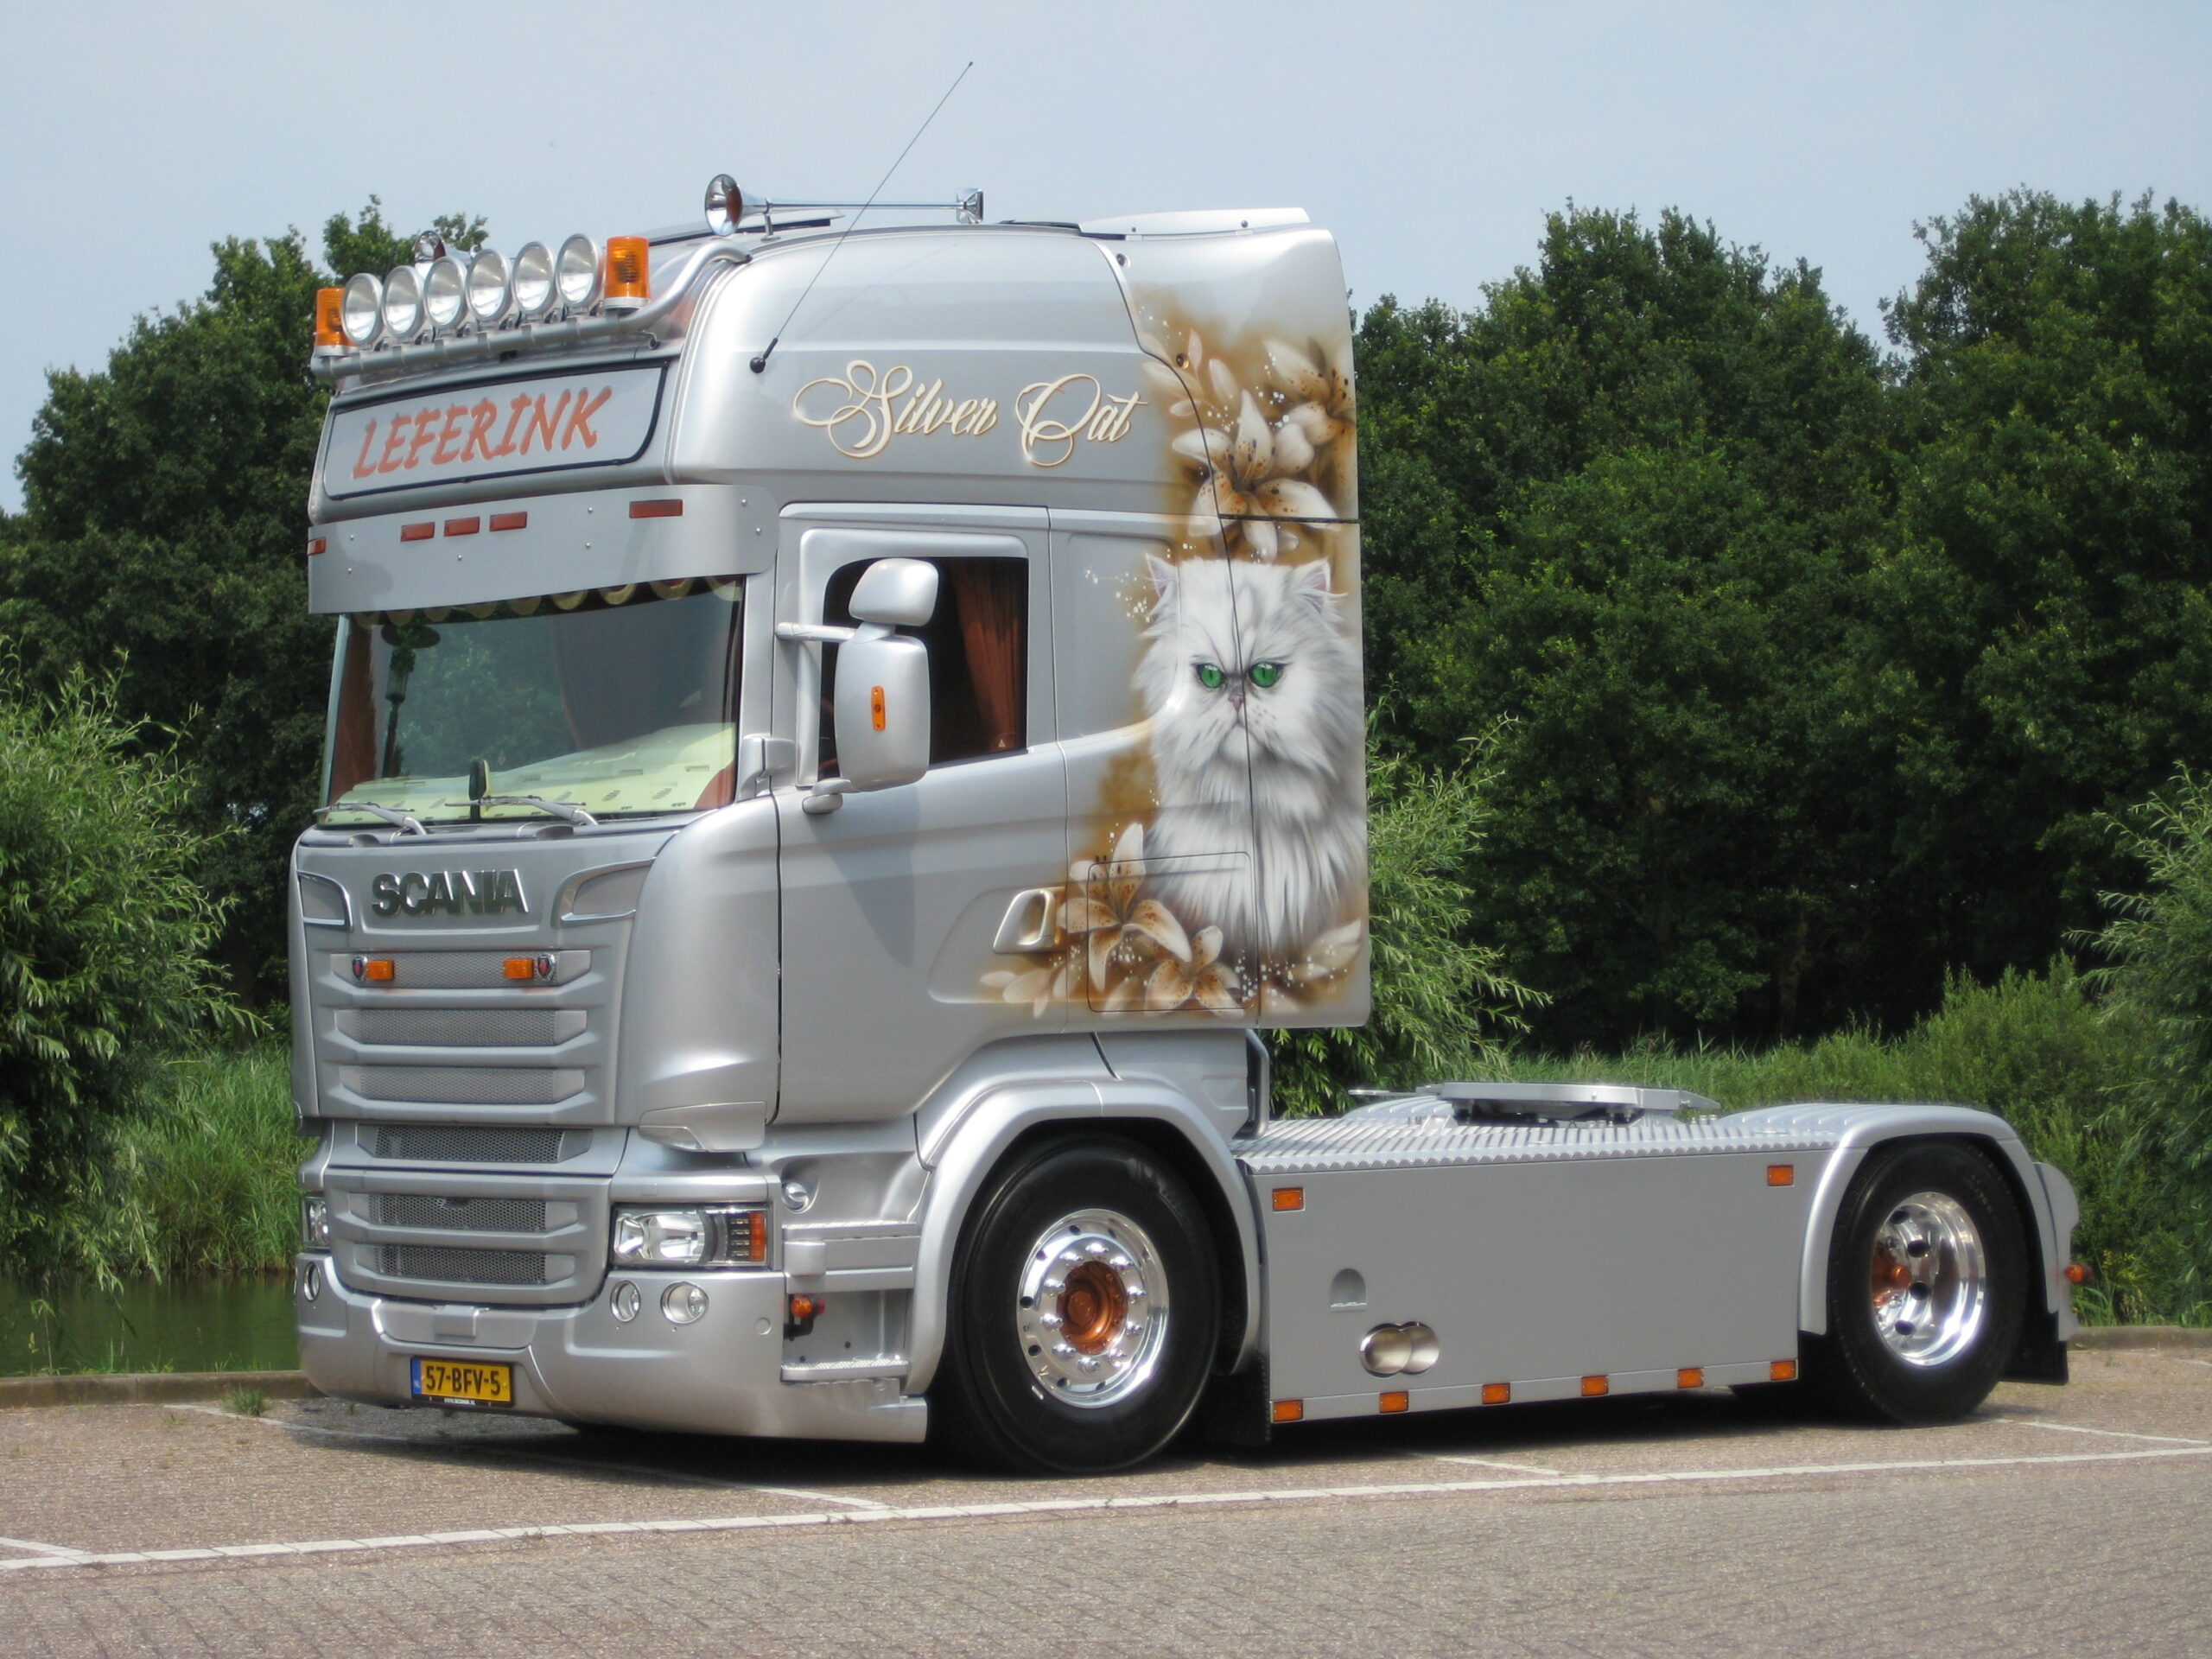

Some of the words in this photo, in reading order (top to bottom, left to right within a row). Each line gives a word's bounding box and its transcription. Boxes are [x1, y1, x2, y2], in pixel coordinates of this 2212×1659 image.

[353, 385, 613, 480] LEFERINK
[793, 359, 998, 458] Silver
[1015, 373, 1148, 467] Cat
[372, 868, 529, 916] SCANIA
[426, 1365, 501, 1395] 57-BFV-5
